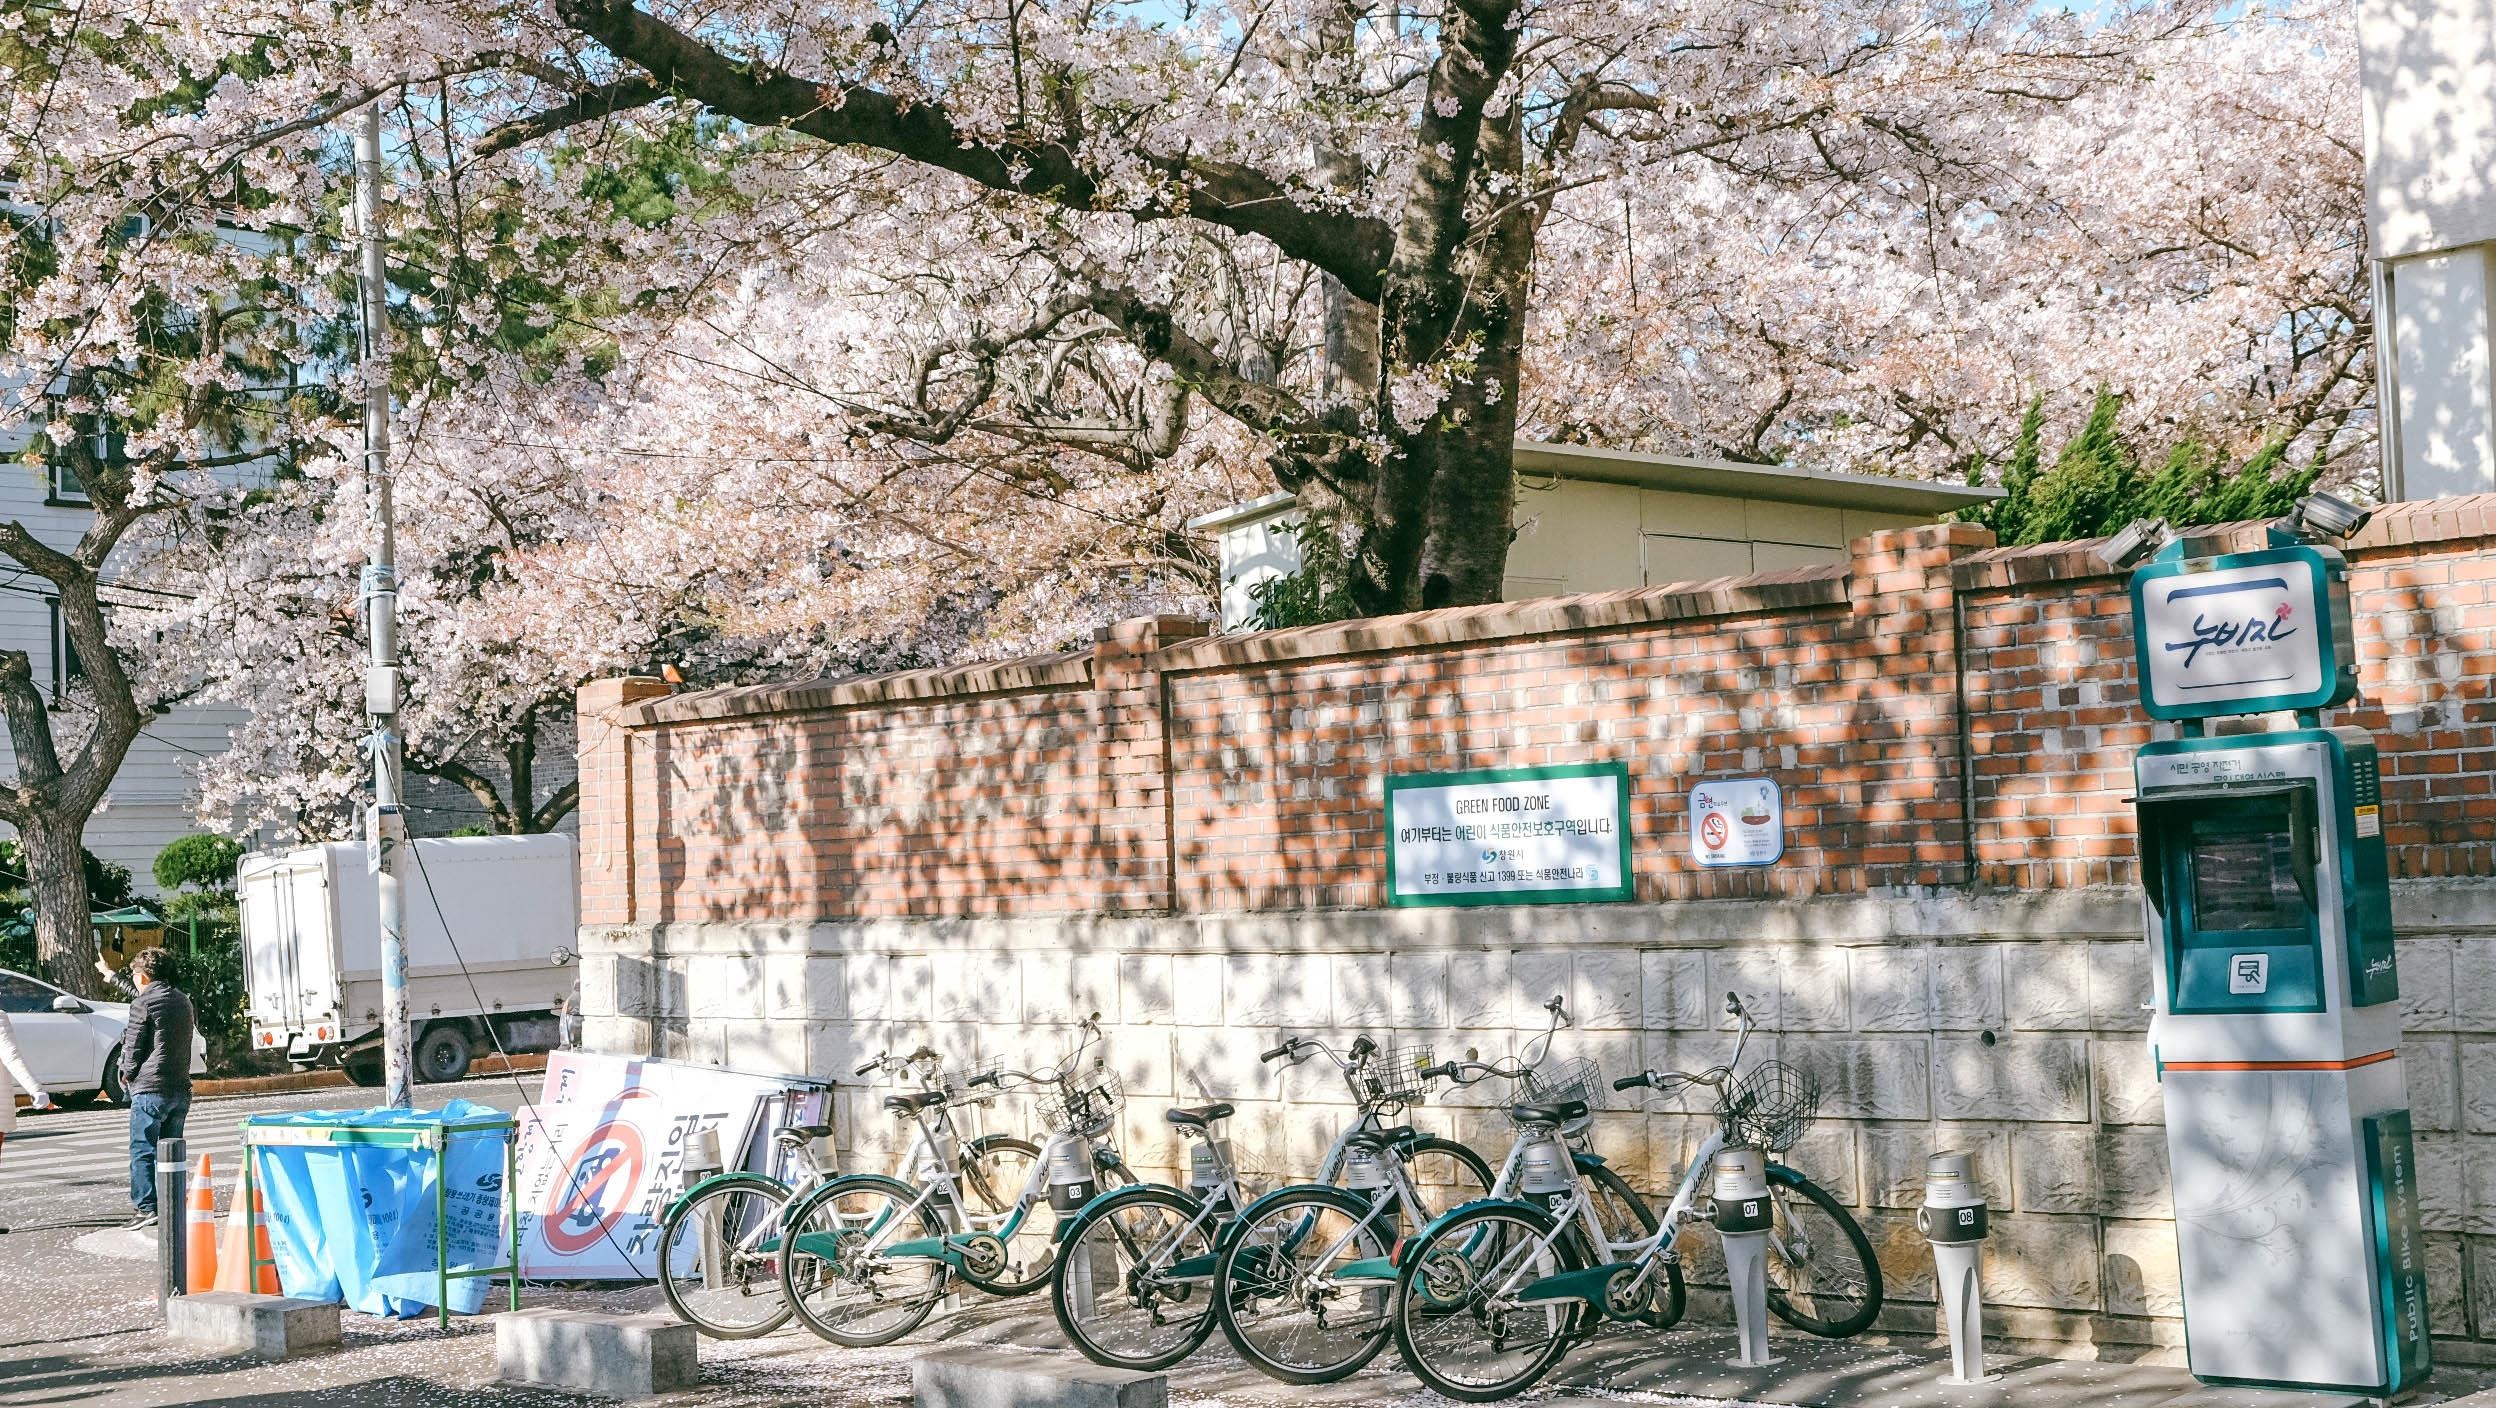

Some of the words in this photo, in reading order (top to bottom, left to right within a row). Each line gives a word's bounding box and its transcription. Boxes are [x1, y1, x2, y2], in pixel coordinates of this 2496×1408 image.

[2170, 763, 2189, 775] 시민
[2191, 762, 2210, 774] 공영
[2212, 759, 2241, 771] 자전거
[1456, 798, 1489, 815] GREEN
[1492, 796, 1520, 813] FOOD
[1523, 794, 1551, 811] ZONE
[1400, 826, 1453, 844] 여기부터는
[1455, 824, 1487, 841] 어린이
[1489, 817, 1614, 840] 식품안전보호구역입니다.
[1498, 848, 1525, 861] 창원시
[1424, 873, 1439, 885] 부정
[1479, 870, 1495, 883] 신고
[1497, 870, 1516, 882] 1399
[1517, 869, 1535, 881] 또는
[1536, 867, 1584, 881] 식품안전나라
[2393, 1144, 2408, 1219] System
[1069, 1187, 1081, 1197] 03
[1744, 1204, 1757, 1215] 07
[1960, 1211, 1973, 1222] 08
[2400, 1225, 2413, 1270] Bike
[2404, 1275, 2419, 1342] Public
